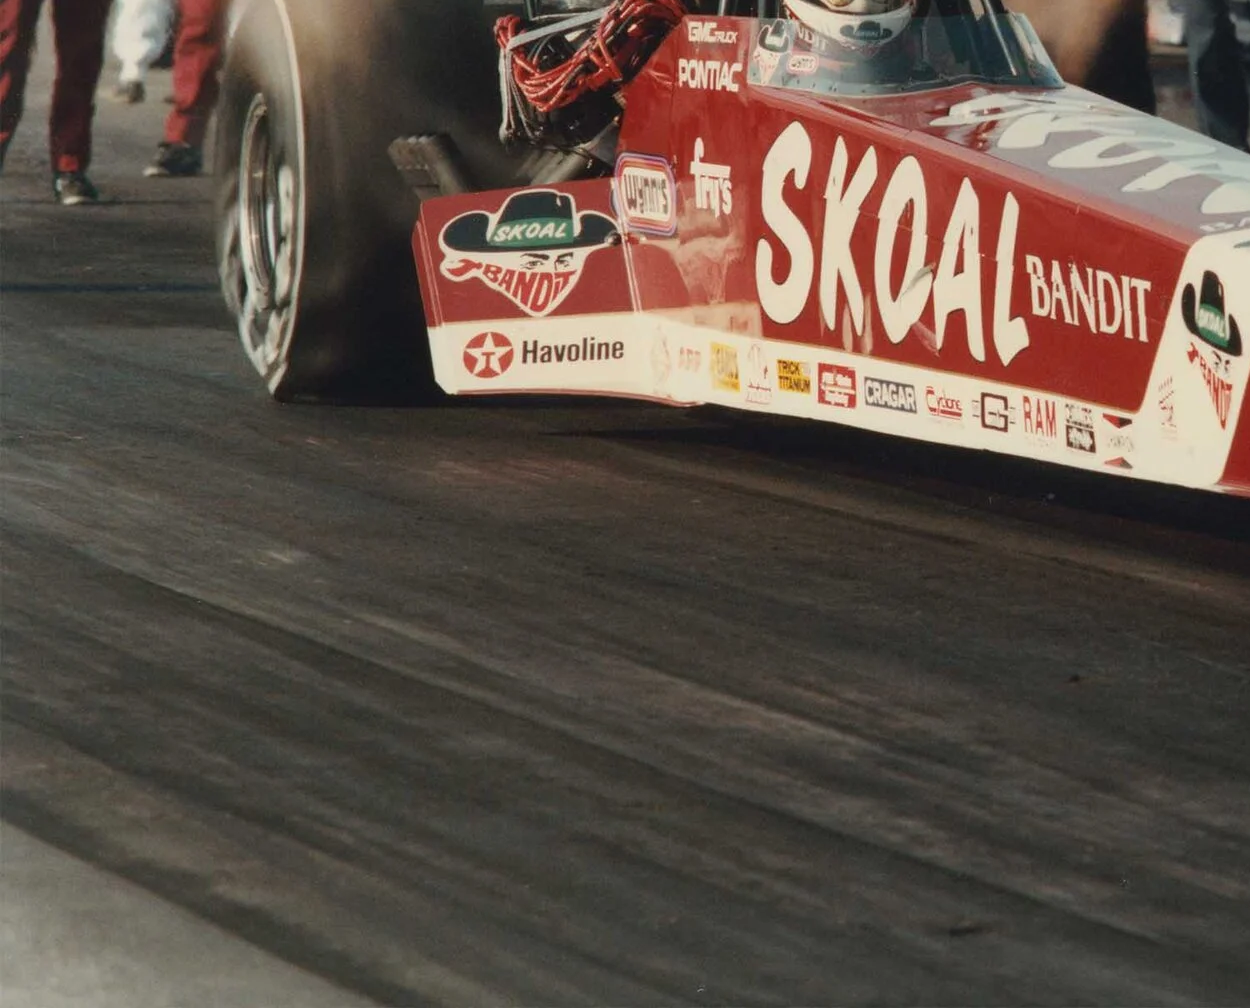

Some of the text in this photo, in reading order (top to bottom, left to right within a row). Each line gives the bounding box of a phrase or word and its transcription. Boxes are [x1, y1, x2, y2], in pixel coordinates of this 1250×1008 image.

[678, 58, 743, 92] PONTIAC
[494, 222, 567, 243] SKOAL
[756, 120, 1152, 367] SKOAL BANDIT
[483, 263, 577, 313] BANDIT
[522, 337, 624, 365] Havoline
[777, 359, 800, 376] TRICK
[866, 379, 916, 412] CRAGAR
[1023, 396, 1056, 438] RAM
